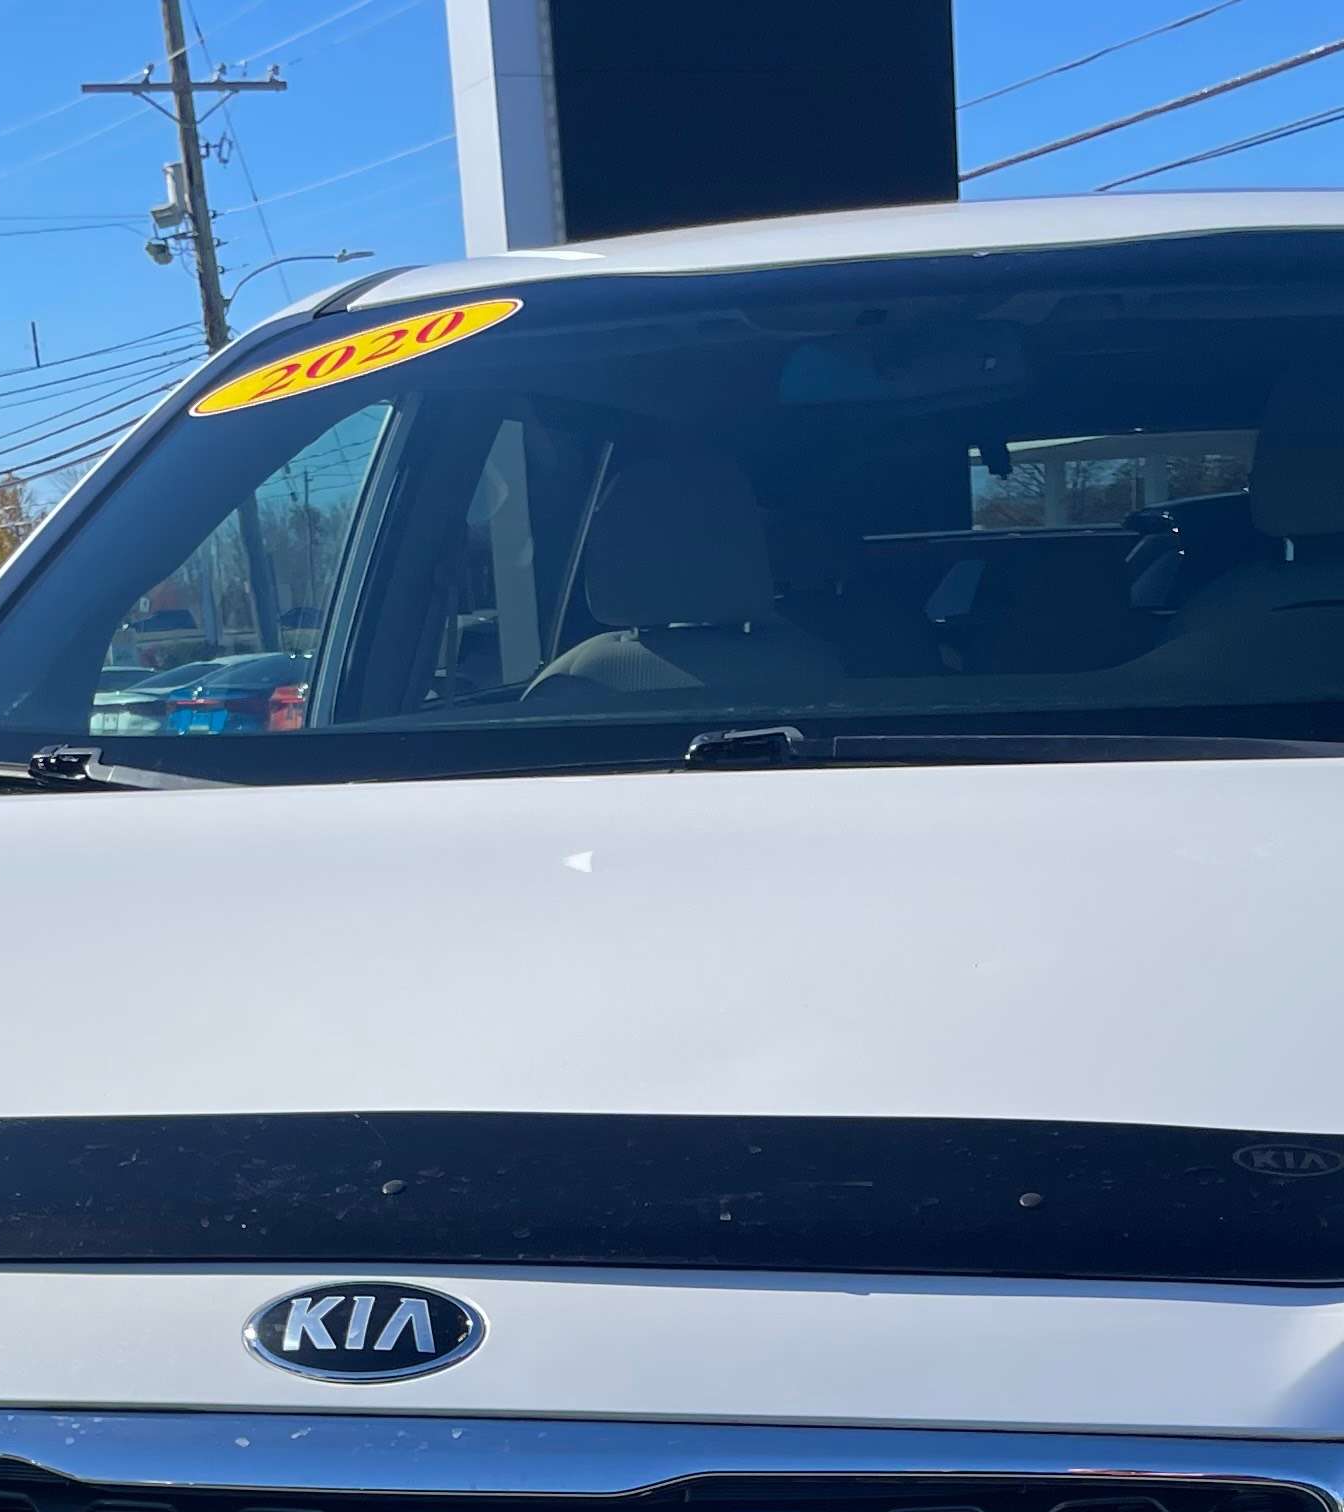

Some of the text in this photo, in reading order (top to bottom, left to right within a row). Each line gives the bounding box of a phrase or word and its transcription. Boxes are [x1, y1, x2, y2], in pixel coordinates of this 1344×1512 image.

[249, 311, 465, 401] 2020
[1251, 1150, 1330, 1170] KIA
[282, 1295, 437, 1354] KIA
